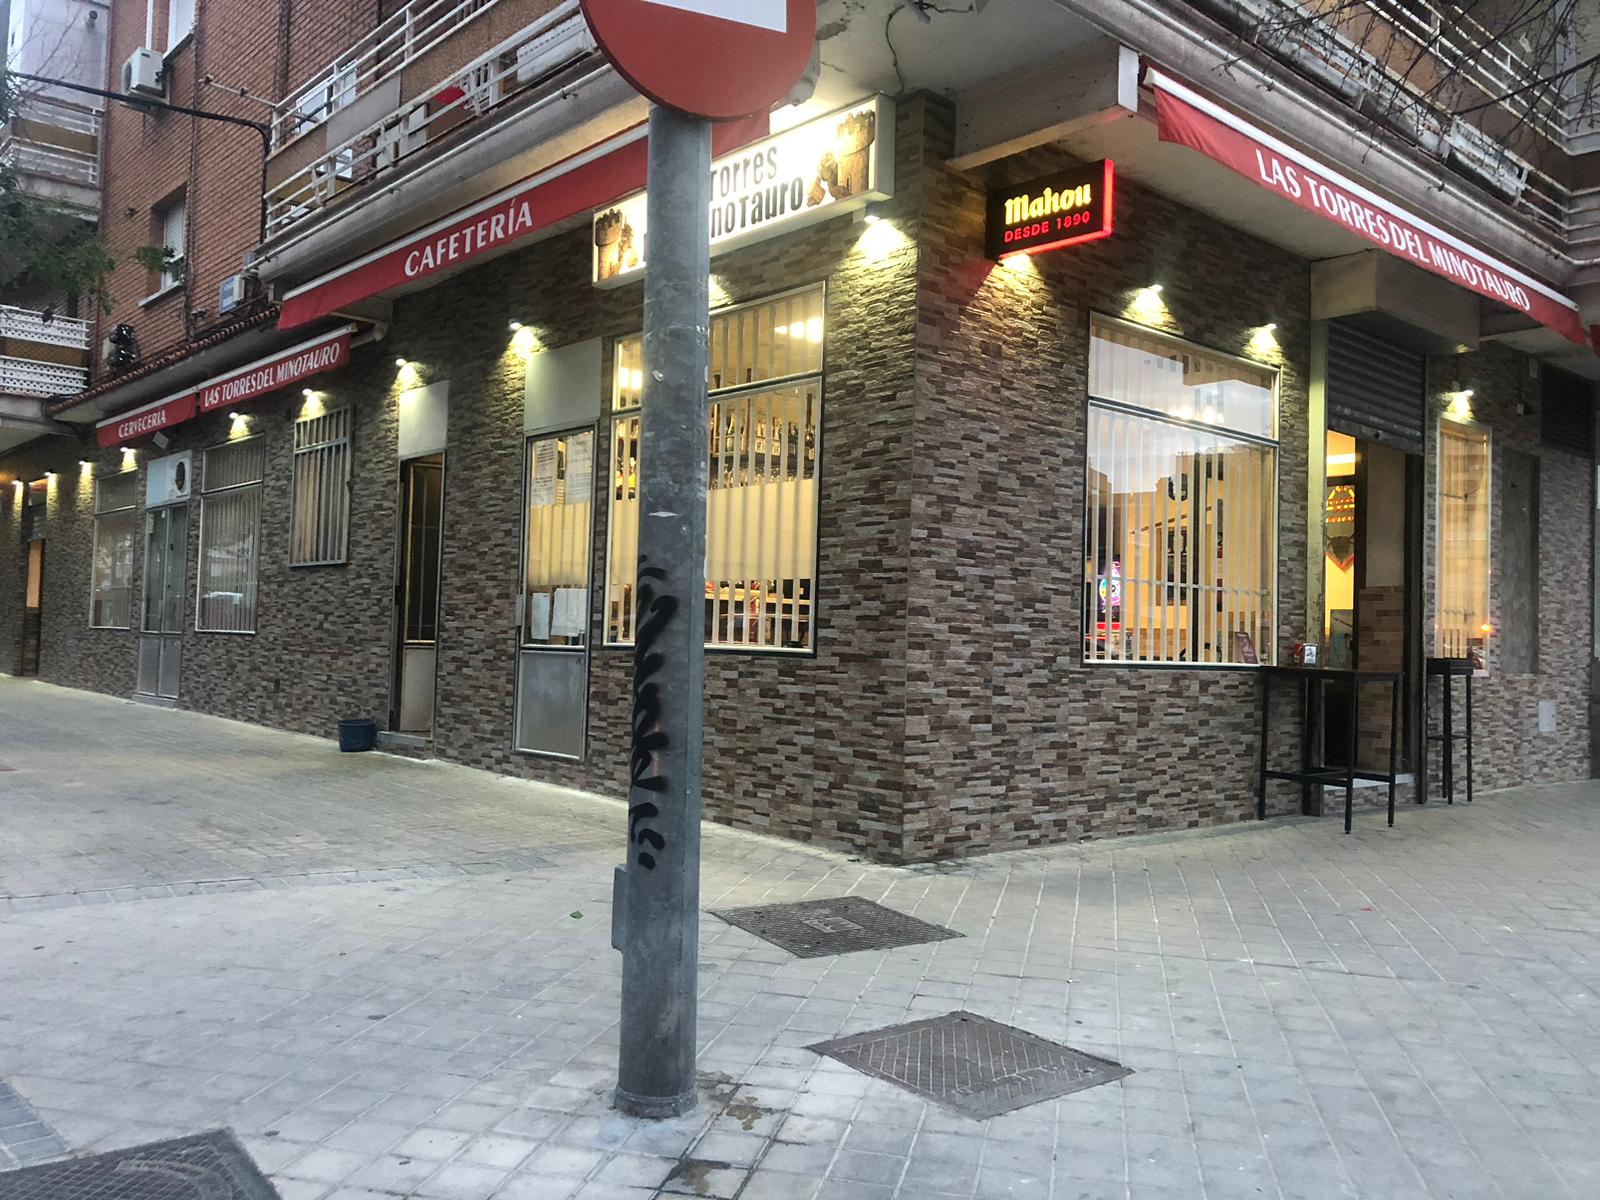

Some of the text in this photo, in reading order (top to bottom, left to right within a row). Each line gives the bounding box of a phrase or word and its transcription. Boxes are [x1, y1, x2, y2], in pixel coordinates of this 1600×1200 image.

[1004, 183, 1092, 226] Mahou
[1004, 211, 1091, 244] DESDE 1890
[1255, 148, 1530, 311] LAS TORRES DEL MINOTAURO
[404, 198, 533, 277] CAFETERÍA
[204, 342, 340, 408] LAS TORRES DEL MINOTAURO
[118, 407, 167, 439] CERVECERÍA
